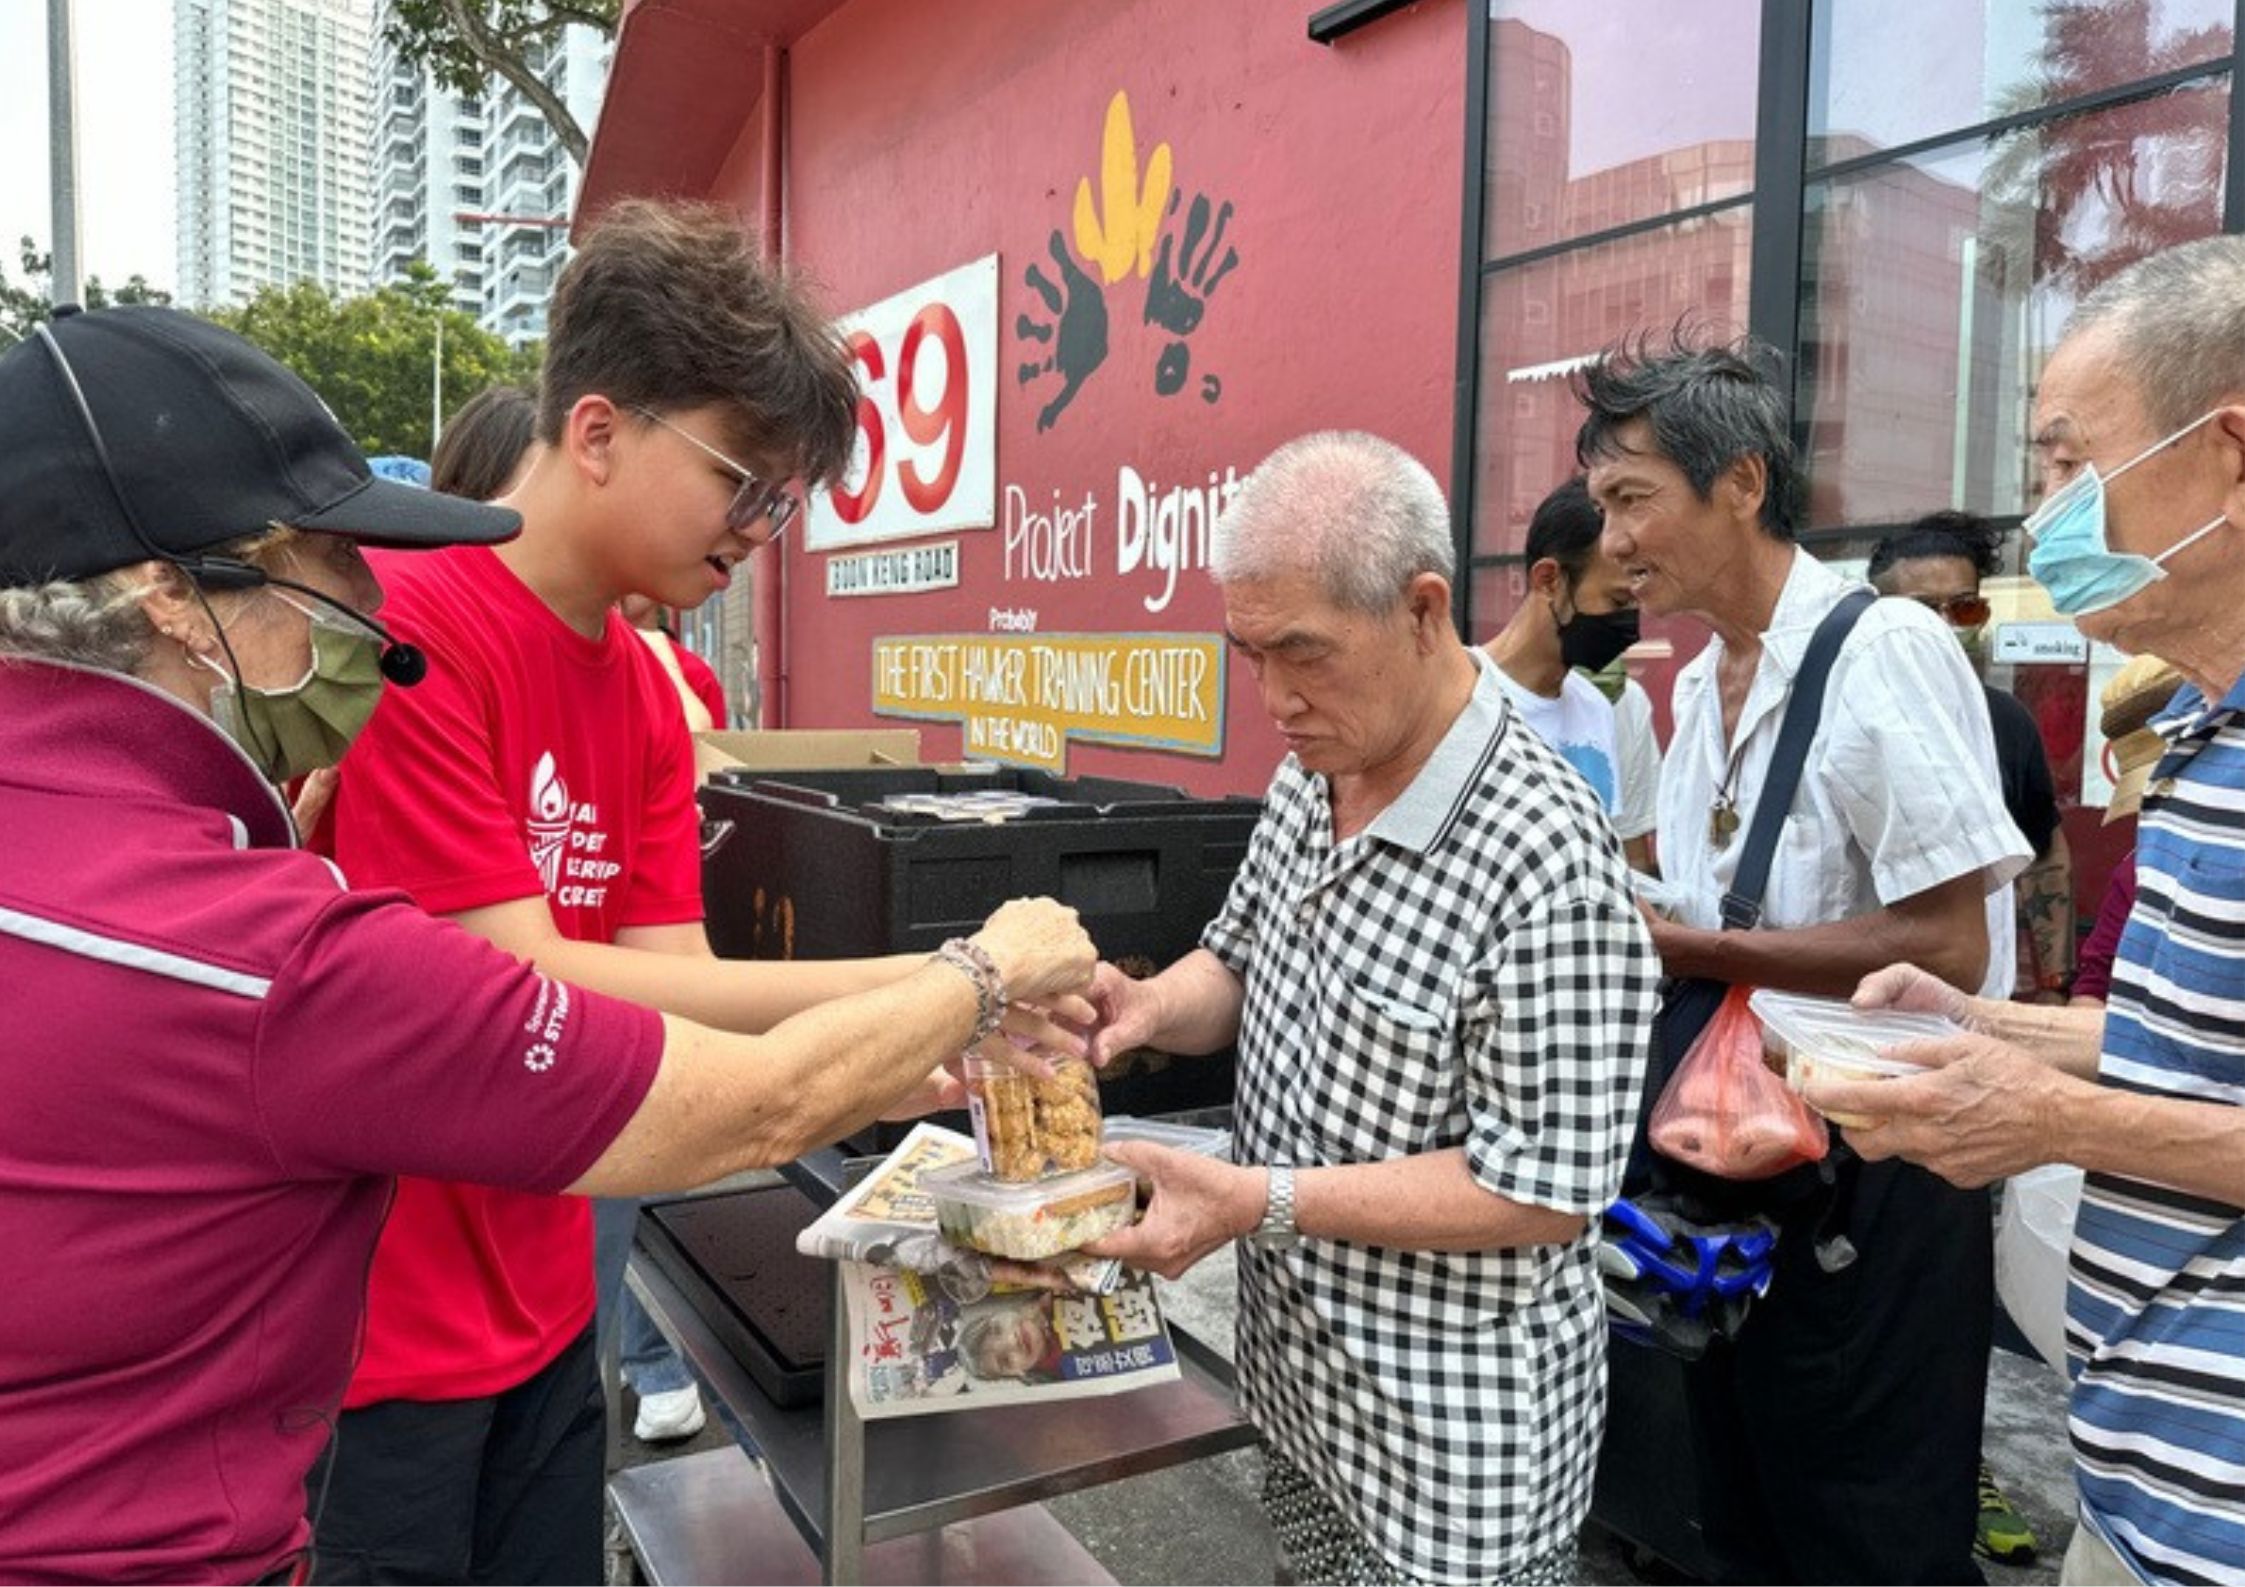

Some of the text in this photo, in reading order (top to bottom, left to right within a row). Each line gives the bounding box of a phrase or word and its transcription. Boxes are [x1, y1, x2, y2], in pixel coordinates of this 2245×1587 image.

[1004, 465, 1246, 613] Project Dignit
[872, 553, 908, 586] KENG
[915, 548, 953, 582] ROAD
[989, 606, 1038, 632] Probably
[878, 645, 1207, 722] THE FIRST HAWKER TRAINING CENTER
[971, 717, 1058, 760] IN THE WORLD
